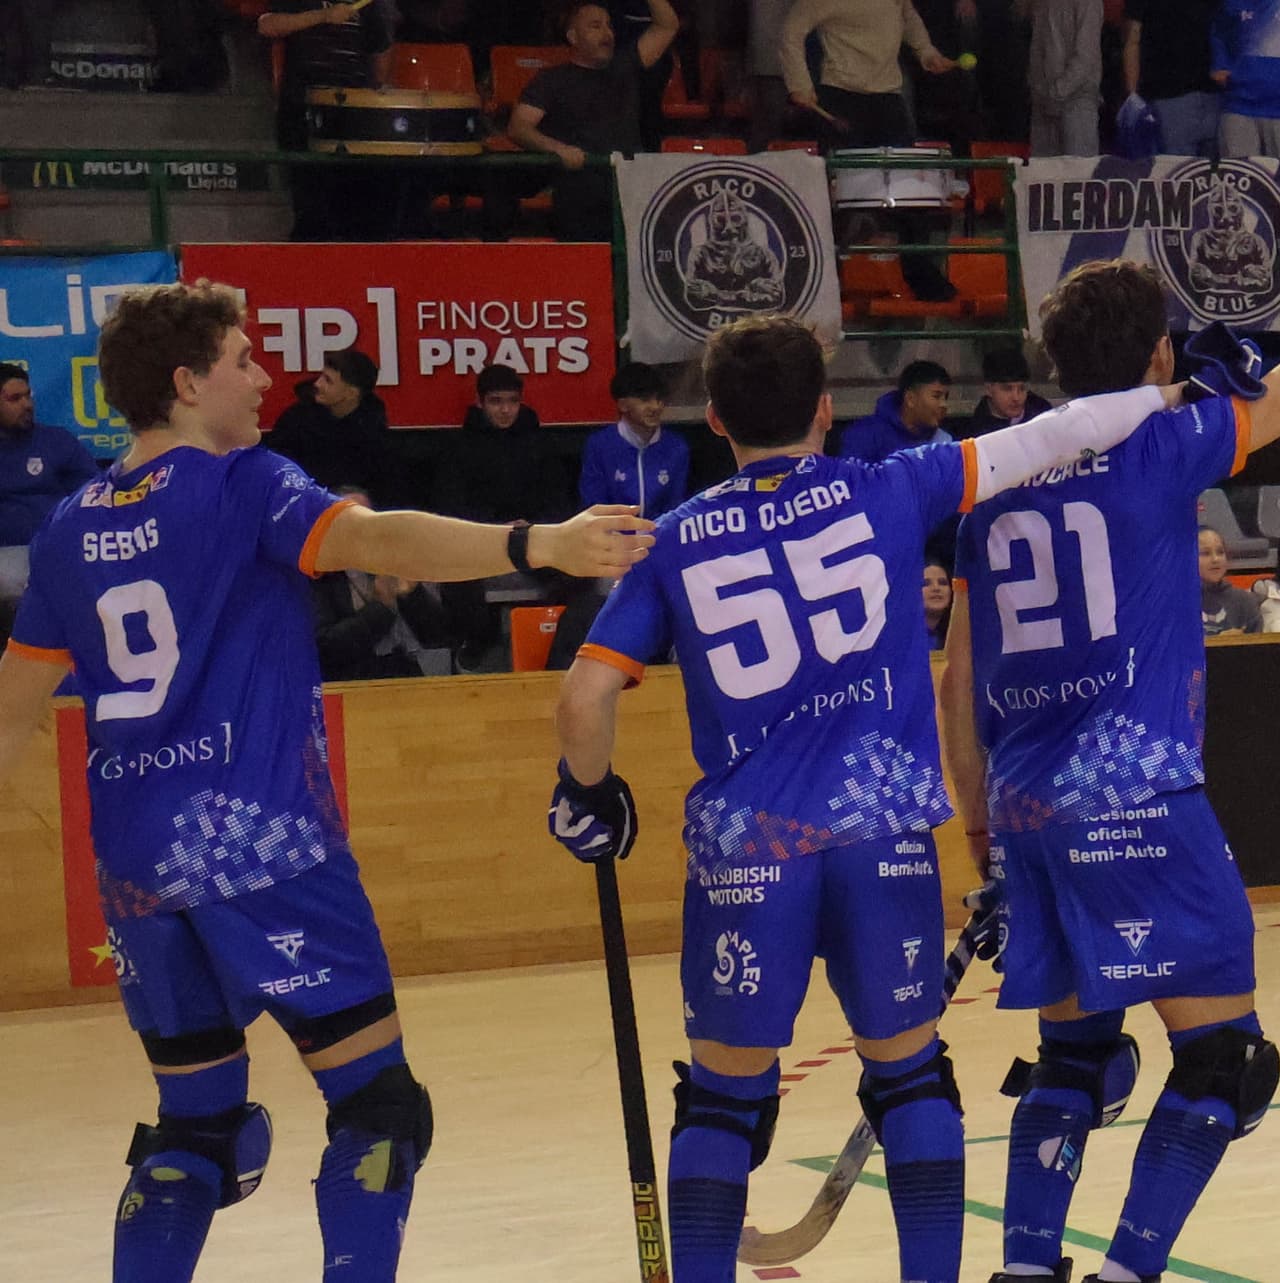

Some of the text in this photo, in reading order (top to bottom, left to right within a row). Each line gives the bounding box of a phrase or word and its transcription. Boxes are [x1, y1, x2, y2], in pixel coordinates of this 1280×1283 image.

[1028, 180, 1192, 231] ILERDAM
[417, 300, 588, 335] FINQUES
[1203, 294, 1258, 313] BLUE
[418, 337, 590, 376] PRATS
[680, 479, 851, 545] NICO OJEDA
[986, 501, 1118, 655] 21
[680, 511, 890, 701] 55
[95, 578, 181, 723] 9
[1086, 826, 1143, 842] oficial
[1099, 961, 1177, 980] REPLIC
